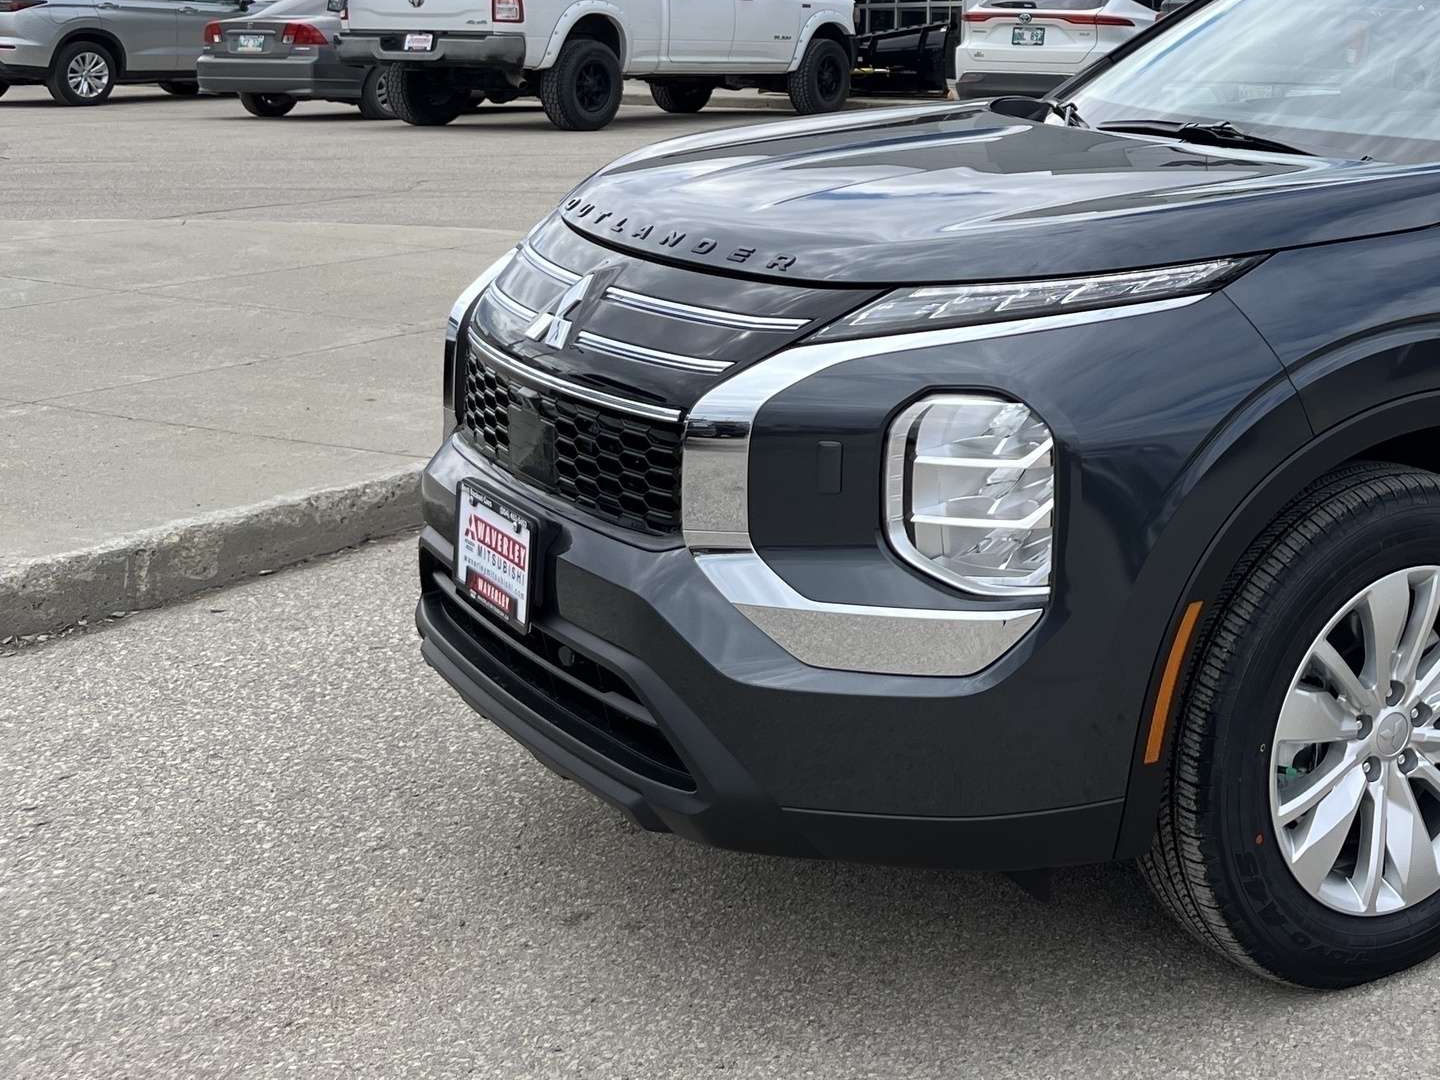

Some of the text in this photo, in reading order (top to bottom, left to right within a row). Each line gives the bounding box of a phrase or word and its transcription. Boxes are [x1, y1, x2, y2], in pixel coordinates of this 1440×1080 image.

[563, 197, 798, 272] OUTLANDER
[477, 520, 526, 567] WAVERLEY
[477, 544, 525, 587] MITSUBISHI
[478, 577, 510, 611] WAVERLEY
